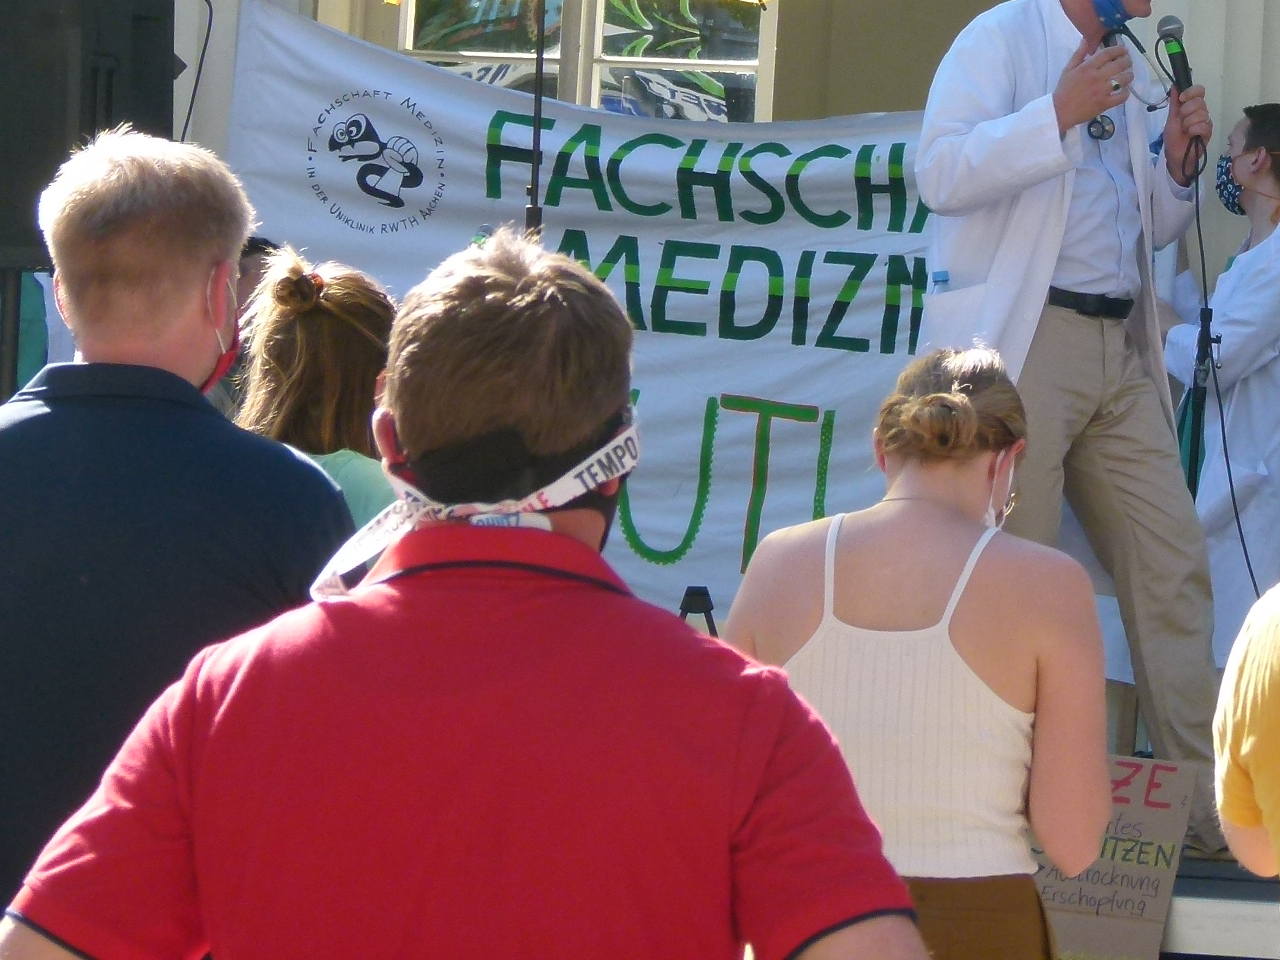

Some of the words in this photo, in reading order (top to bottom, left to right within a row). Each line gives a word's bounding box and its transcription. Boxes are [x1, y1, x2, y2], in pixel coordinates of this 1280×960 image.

[307, 89, 393, 154] FACHSCHAFT
[400, 96, 445, 170] MEDIZIN
[485, 110, 930, 235] FACHSCH
[311, 183, 329, 204] DER
[329, 202, 376, 235] UNIKLINIK
[380, 214, 420, 235] RWTH
[419, 182, 446, 220] AACHEN
[573, 436, 638, 491] TEMPO
